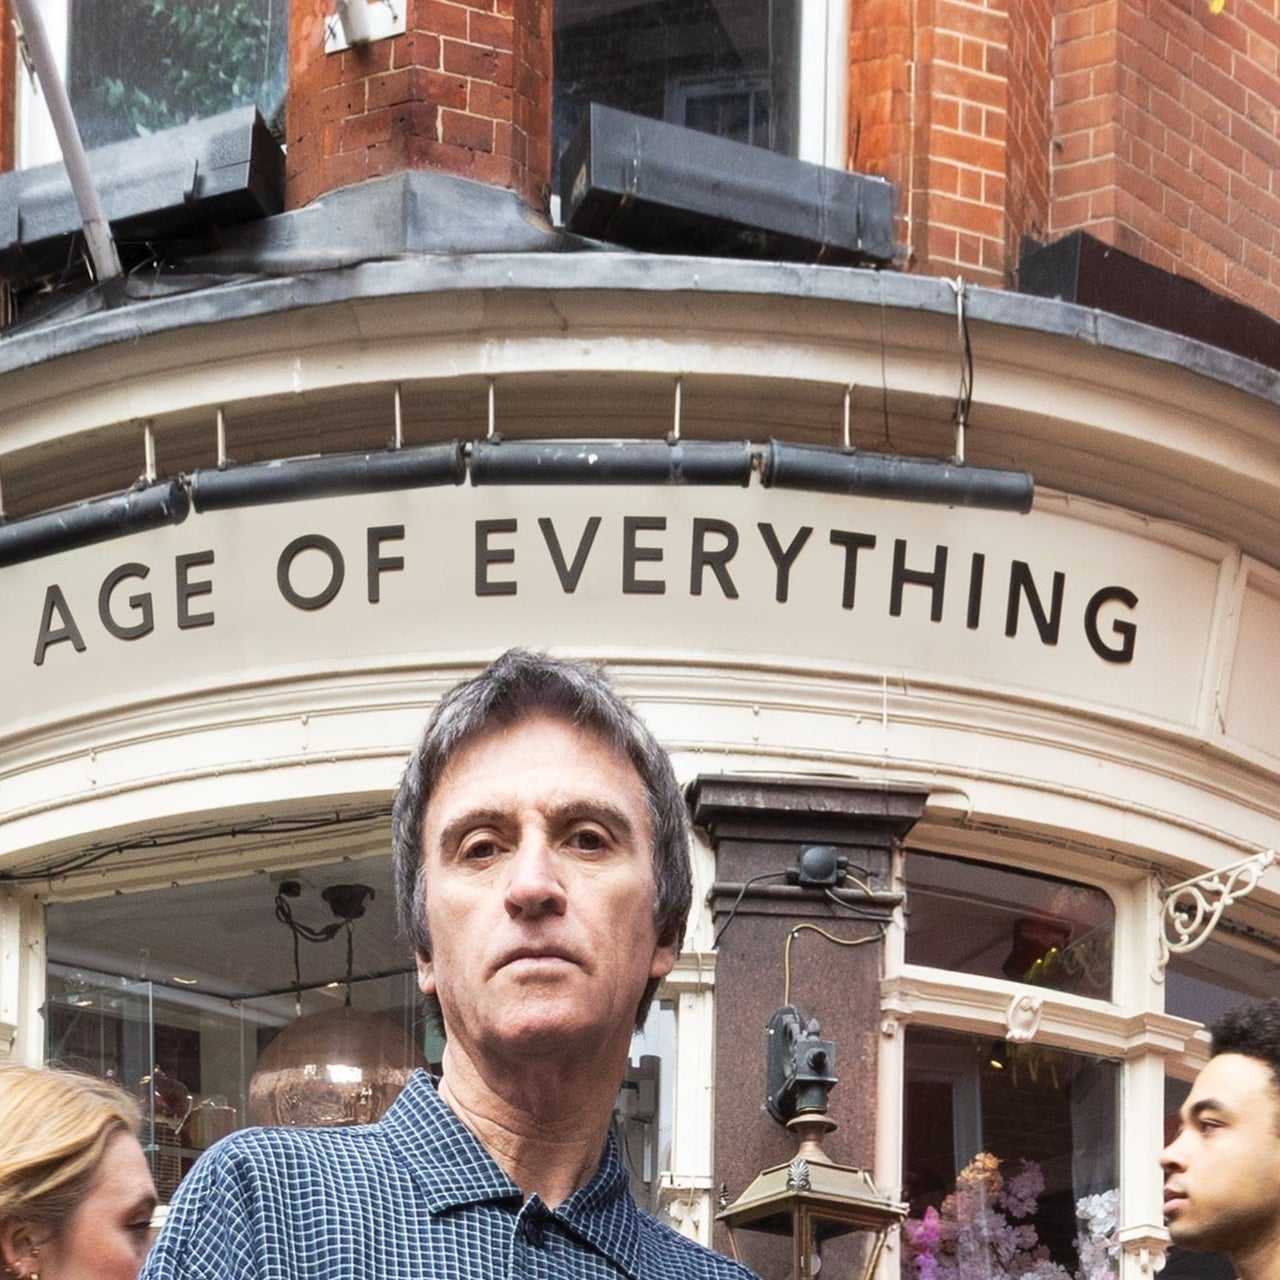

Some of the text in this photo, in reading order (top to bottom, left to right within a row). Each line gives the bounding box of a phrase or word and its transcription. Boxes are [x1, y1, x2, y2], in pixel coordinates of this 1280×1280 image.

[33, 549, 215, 665] AGE
[276, 524, 405, 611] OF
[475, 516, 1140, 664] EVERYTHING
